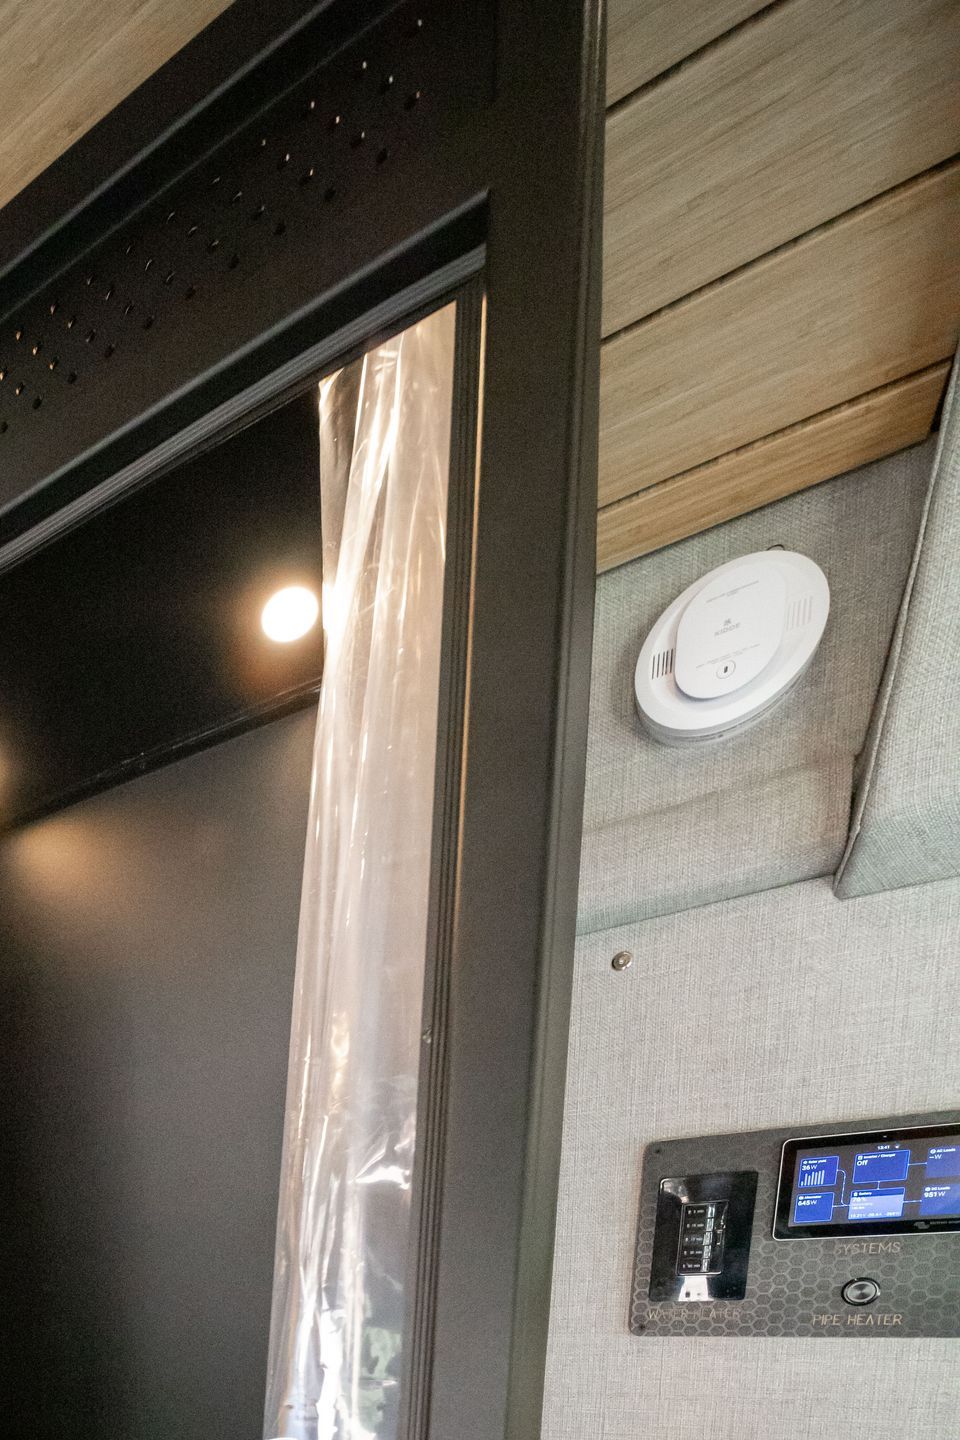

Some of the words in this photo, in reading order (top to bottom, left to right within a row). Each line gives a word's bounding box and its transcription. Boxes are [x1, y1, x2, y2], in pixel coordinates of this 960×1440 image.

[856, 1159, 869, 1167] Off
[834, 1241, 901, 1256] SYSTEMS
[812, 1313, 841, 1326] PIPE
[847, 1313, 903, 1326] HEATER
